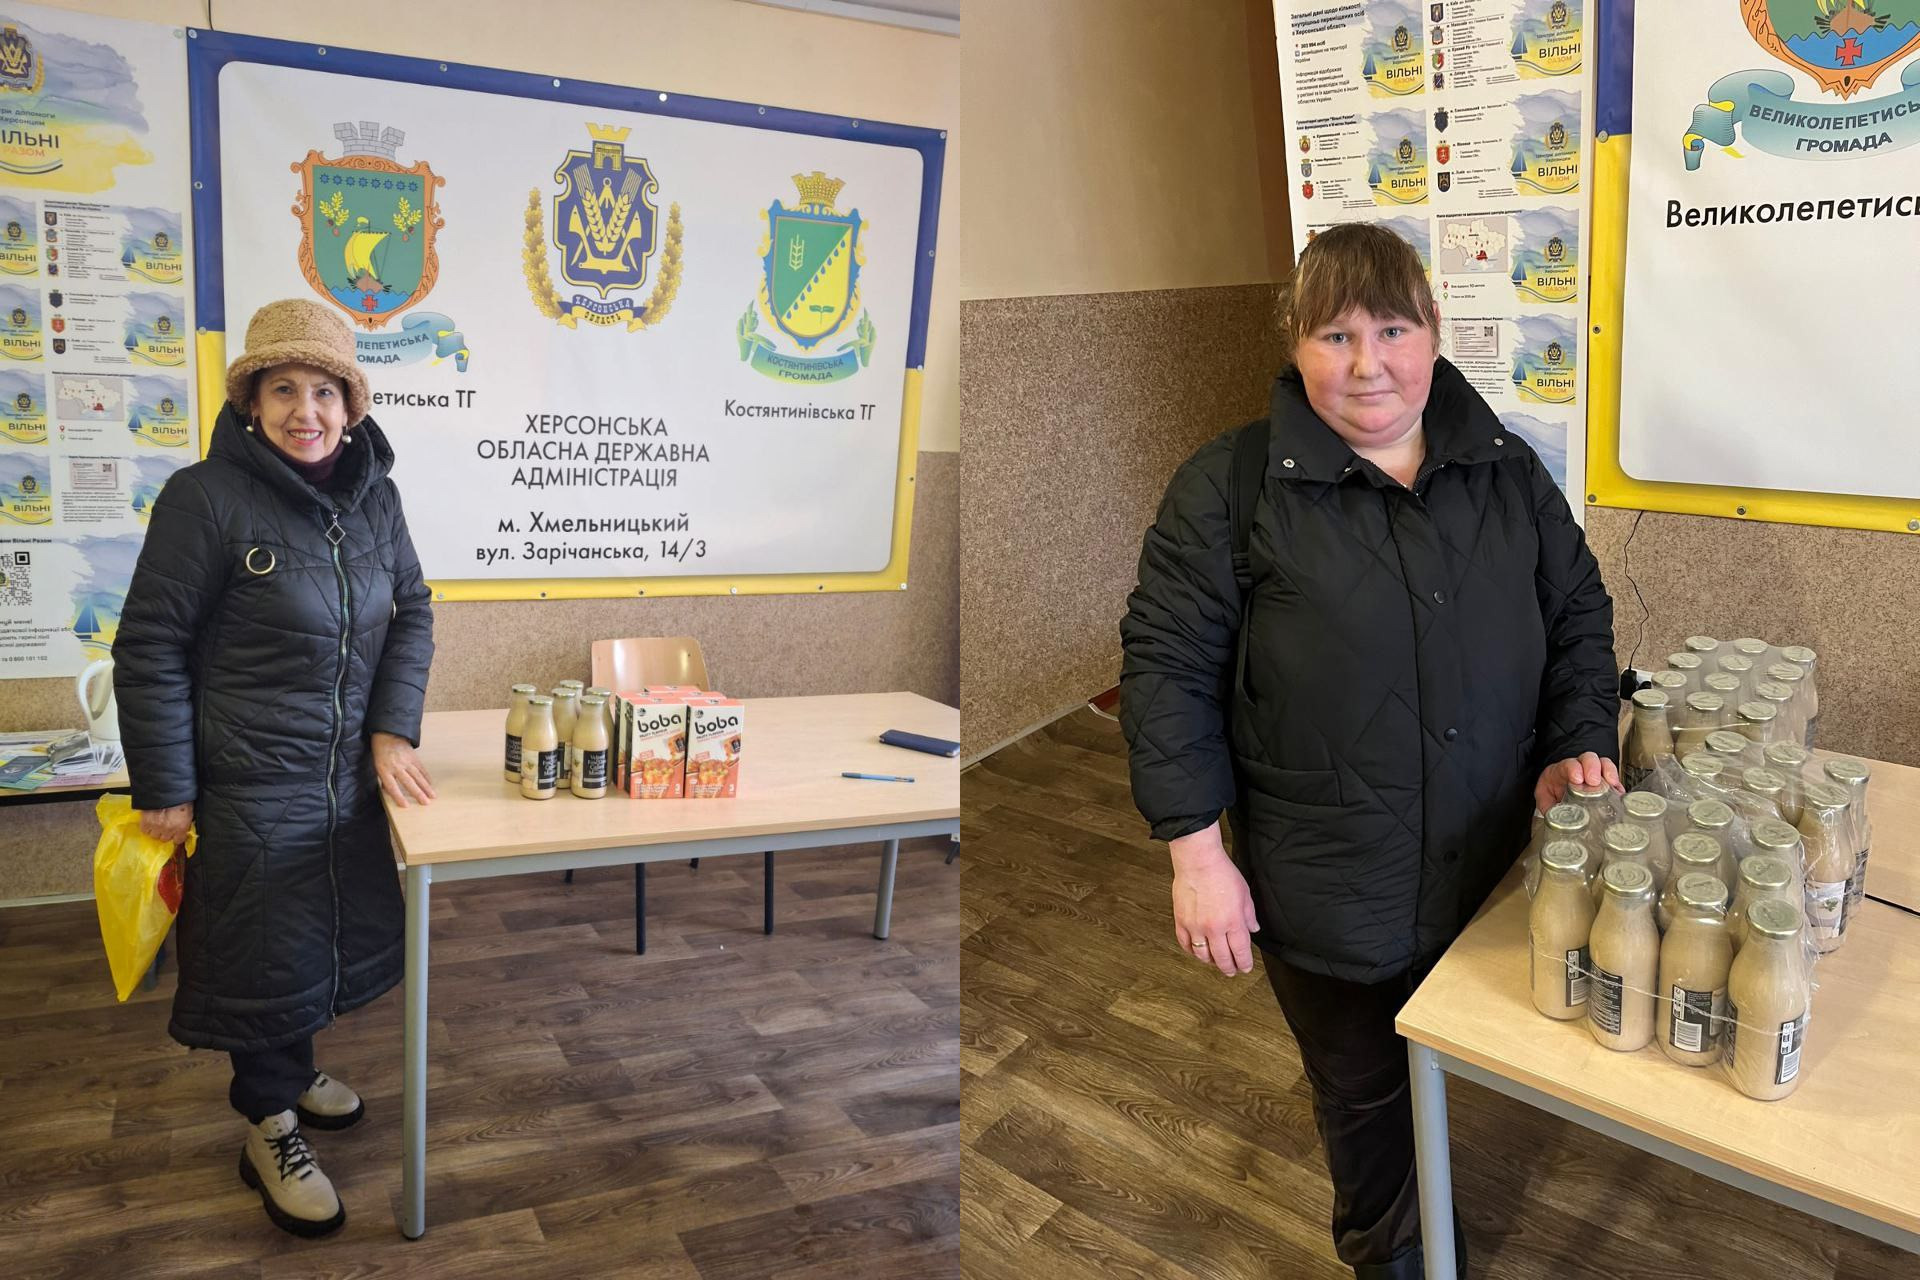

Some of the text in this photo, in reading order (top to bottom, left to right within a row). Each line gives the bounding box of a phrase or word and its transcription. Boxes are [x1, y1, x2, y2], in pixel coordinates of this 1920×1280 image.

[1539, 43, 1581, 59] ВІЛЬНІ
[1386, 65, 1422, 79] ВІЛЬНІ
[15, 109, 56, 119] допомоги
[1749, 100, 1920, 130] ВЕЛИКОЛЕПЕТИСЬ
[2, 129, 59, 148] ІЛЬНІ
[1795, 131, 1893, 153] ГРОМАДА
[1538, 164, 1578, 177] ВІЛЬНІ
[1391, 177, 1426, 188] ВІЛЬНІ
[145, 261, 182, 271] ВІЛЬНІ
[1537, 277, 1576, 286] ВІЛЬНІ
[575, 296, 631, 313] ХЕРСОНСЬКА
[3, 339, 41, 348] ВІЛЬНІ
[148, 345, 184, 354] ВІЛЬНІ
[356, 333, 430, 352] ЛЕПЕТИСЬКА
[356, 353, 401, 364] ОМАДА
[767, 354, 844, 371] КОСТЯНТИНІВСЬКА
[778, 370, 833, 381] ГРОМАДА
[1537, 378, 1574, 388] ВІЛЬНІ
[372, 390, 477, 408] етиська ТГ
[724, 399, 876, 421] Костянтинівська ТГ
[8, 423, 46, 431] ВІЛЬНІ
[152, 426, 187, 435] ВІЛЬНІ
[525, 414, 669, 437] ХЕРСОНСЬКА
[476, 439, 710, 465] ОБЛАСНА ДЕРЖАВНА
[511, 467, 678, 490] АДМІНІСТРАЦІЯ
[13, 504, 50, 512] ВІЛЬНІ
[497, 511, 690, 536] м. Хмельницький
[476, 538, 707, 566] вул. Зарічанська, 14/3
[637, 713, 682, 733] boba
[694, 716, 738, 735] boba
